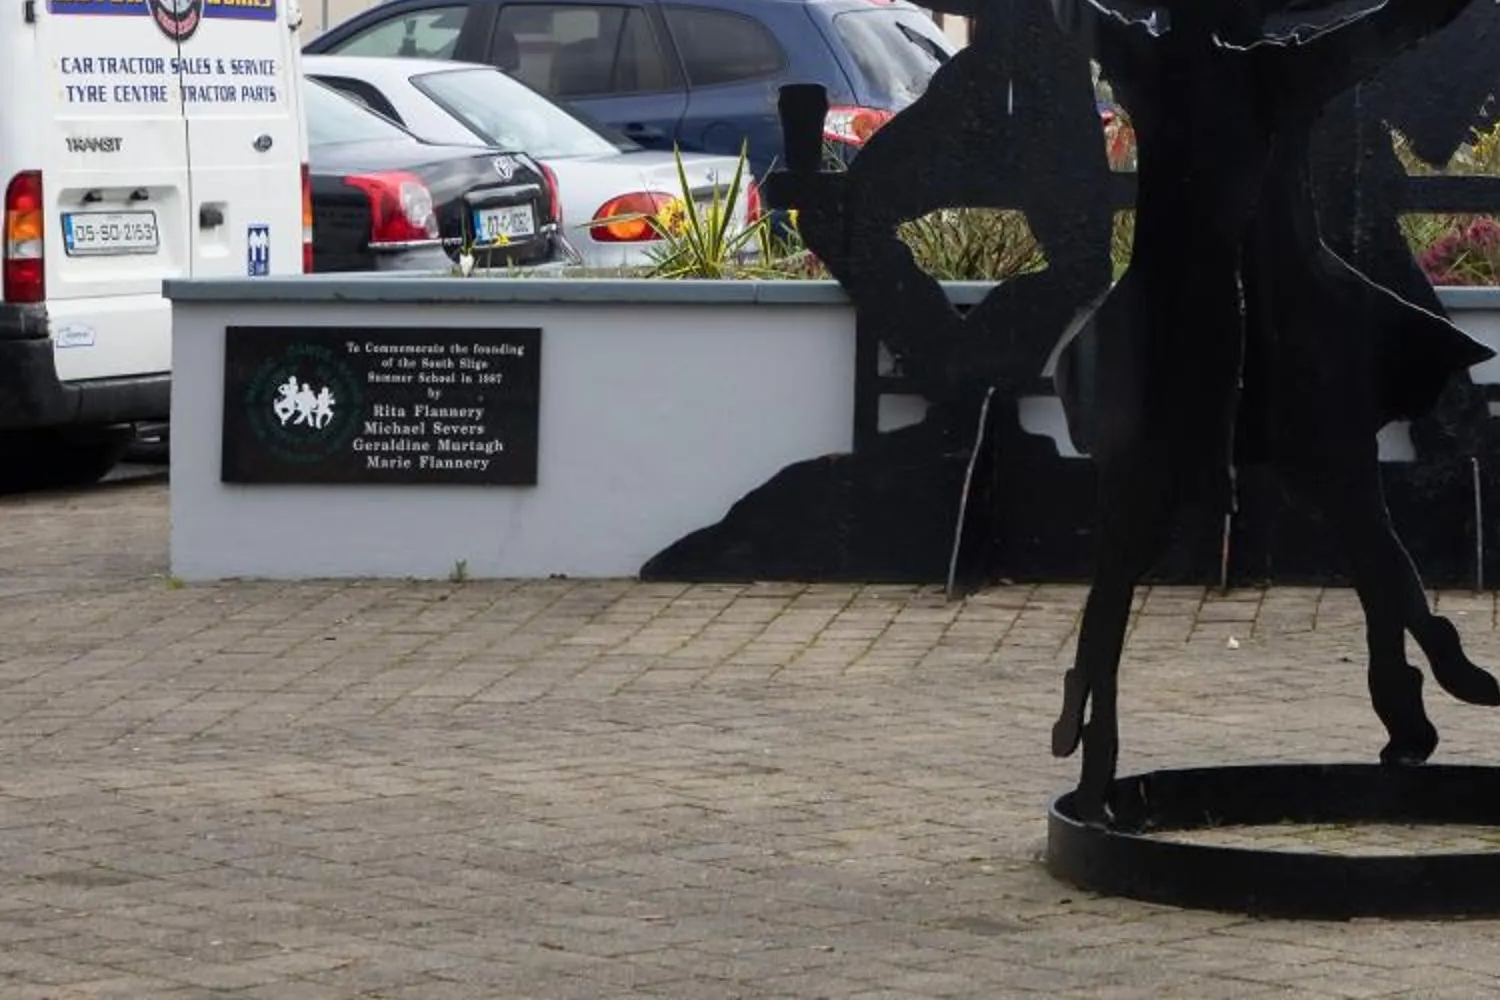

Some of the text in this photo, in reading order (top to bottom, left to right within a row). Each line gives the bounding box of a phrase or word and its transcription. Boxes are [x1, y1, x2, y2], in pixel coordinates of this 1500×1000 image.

[61, 57, 276, 76] CAR TRACTOR SALES & SERVICE
[66, 85, 277, 103] TYRE CENTRE TRACTOR PARTS
[65, 137, 123, 153] TRANSIT
[450, 342, 468, 355] the
[473, 342, 526, 357] founding
[381, 357, 394, 369] of
[398, 357, 417, 370] the
[372, 404, 485, 420] Rita Flannery
[363, 421, 485, 435] Michael Severs
[352, 438, 504, 454] Geraldine Murtagh
[366, 455, 490, 471] Marie Flannery
